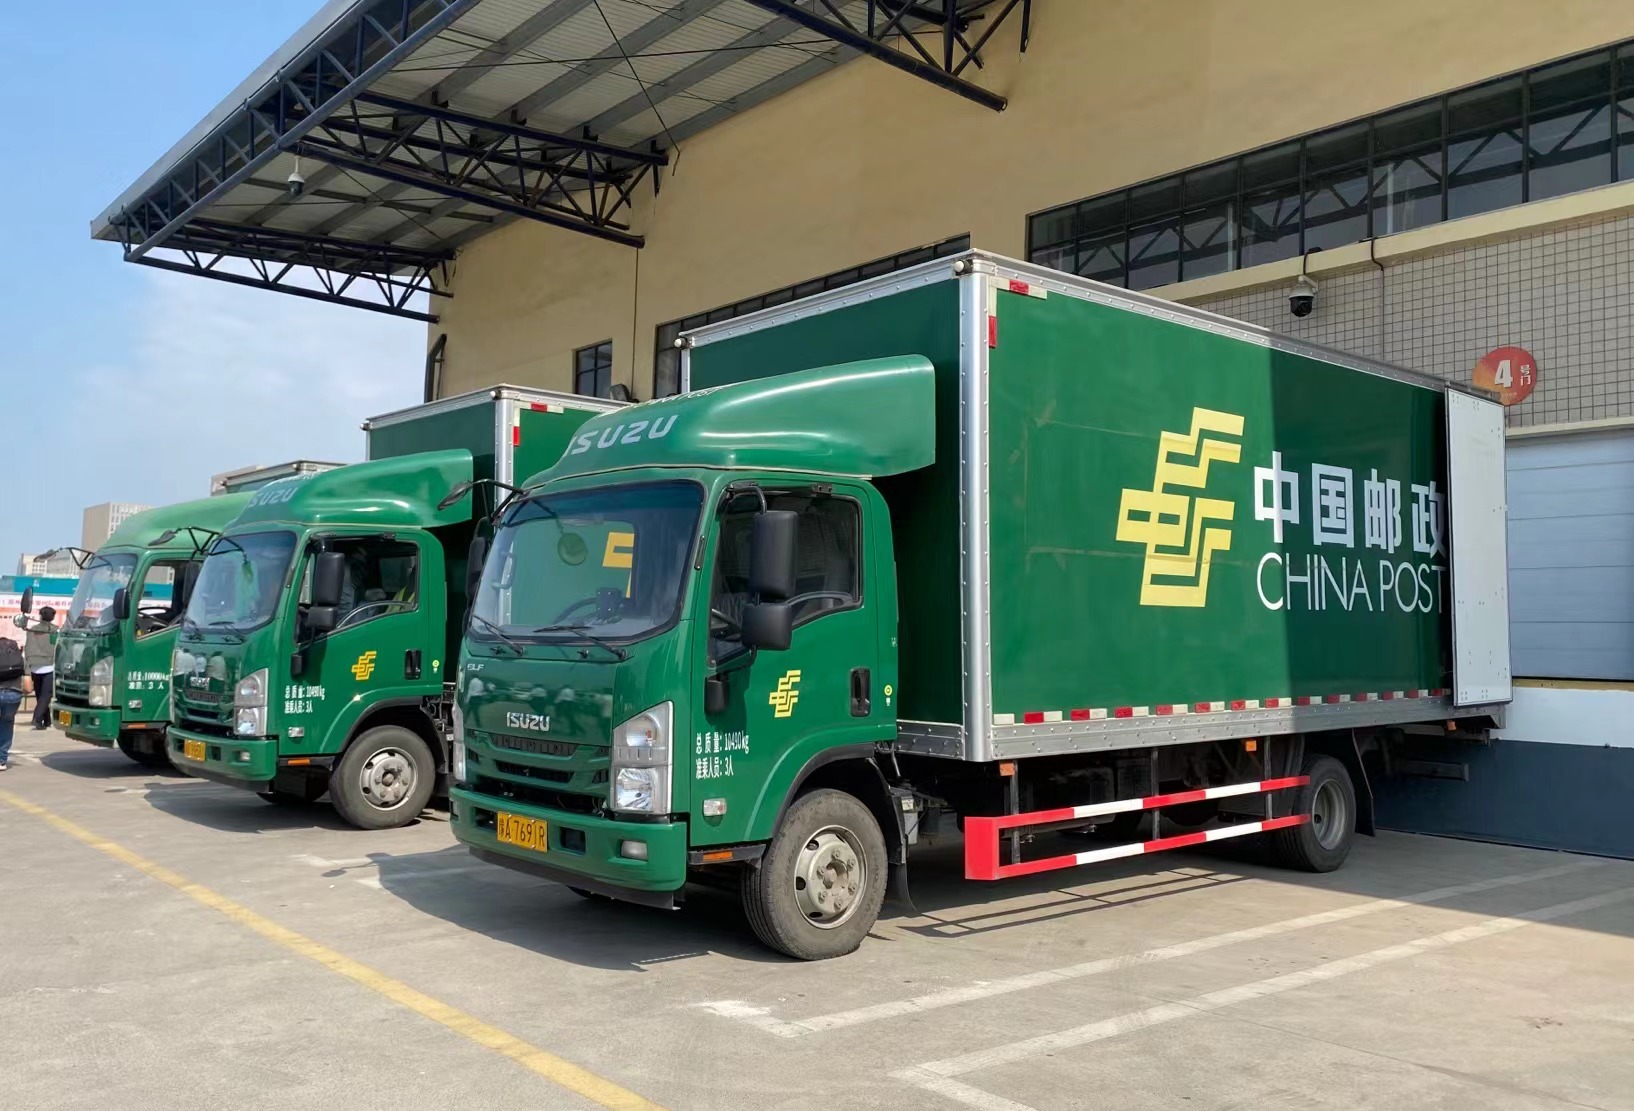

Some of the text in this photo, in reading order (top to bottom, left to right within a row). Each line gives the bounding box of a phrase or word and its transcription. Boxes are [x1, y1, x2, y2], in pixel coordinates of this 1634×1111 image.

[1495, 360, 1513, 388] 4
[1254, 450, 1446, 558] 中国邮政
[1256, 552, 1447, 614] CHINA POST
[506, 711, 550, 731] ISUZU
